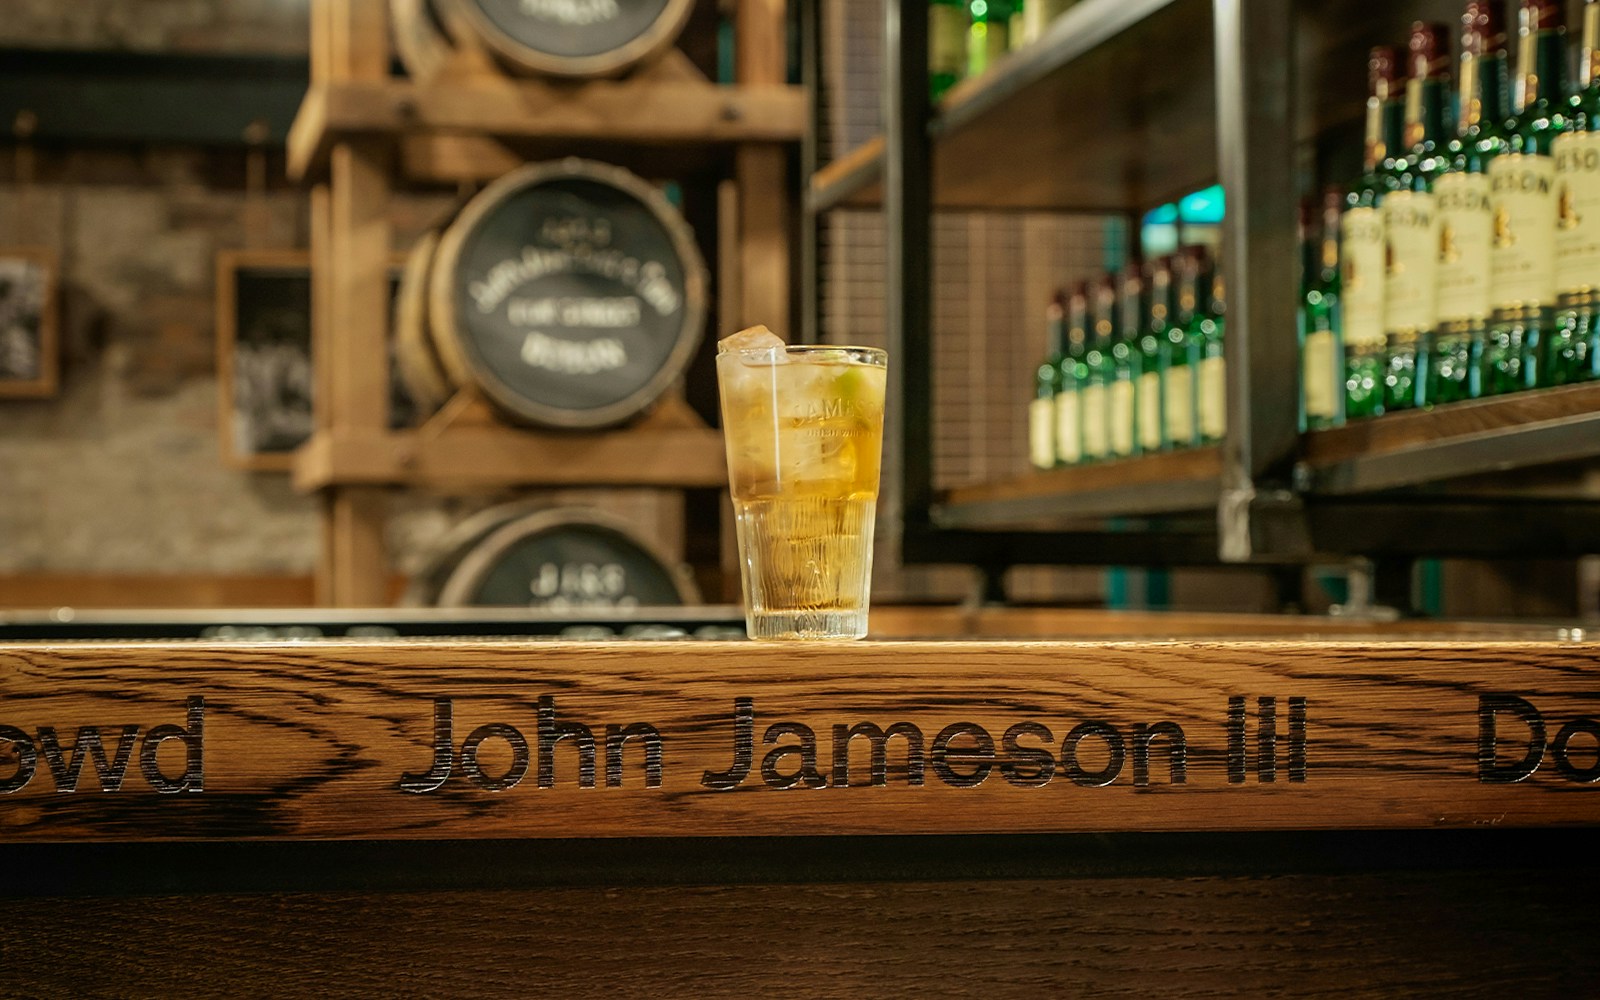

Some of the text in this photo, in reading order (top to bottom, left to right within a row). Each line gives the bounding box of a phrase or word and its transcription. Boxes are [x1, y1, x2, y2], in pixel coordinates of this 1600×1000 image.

[400, 695, 1307, 793] John Jameson III
[1479, 693, 1600, 784] Do
